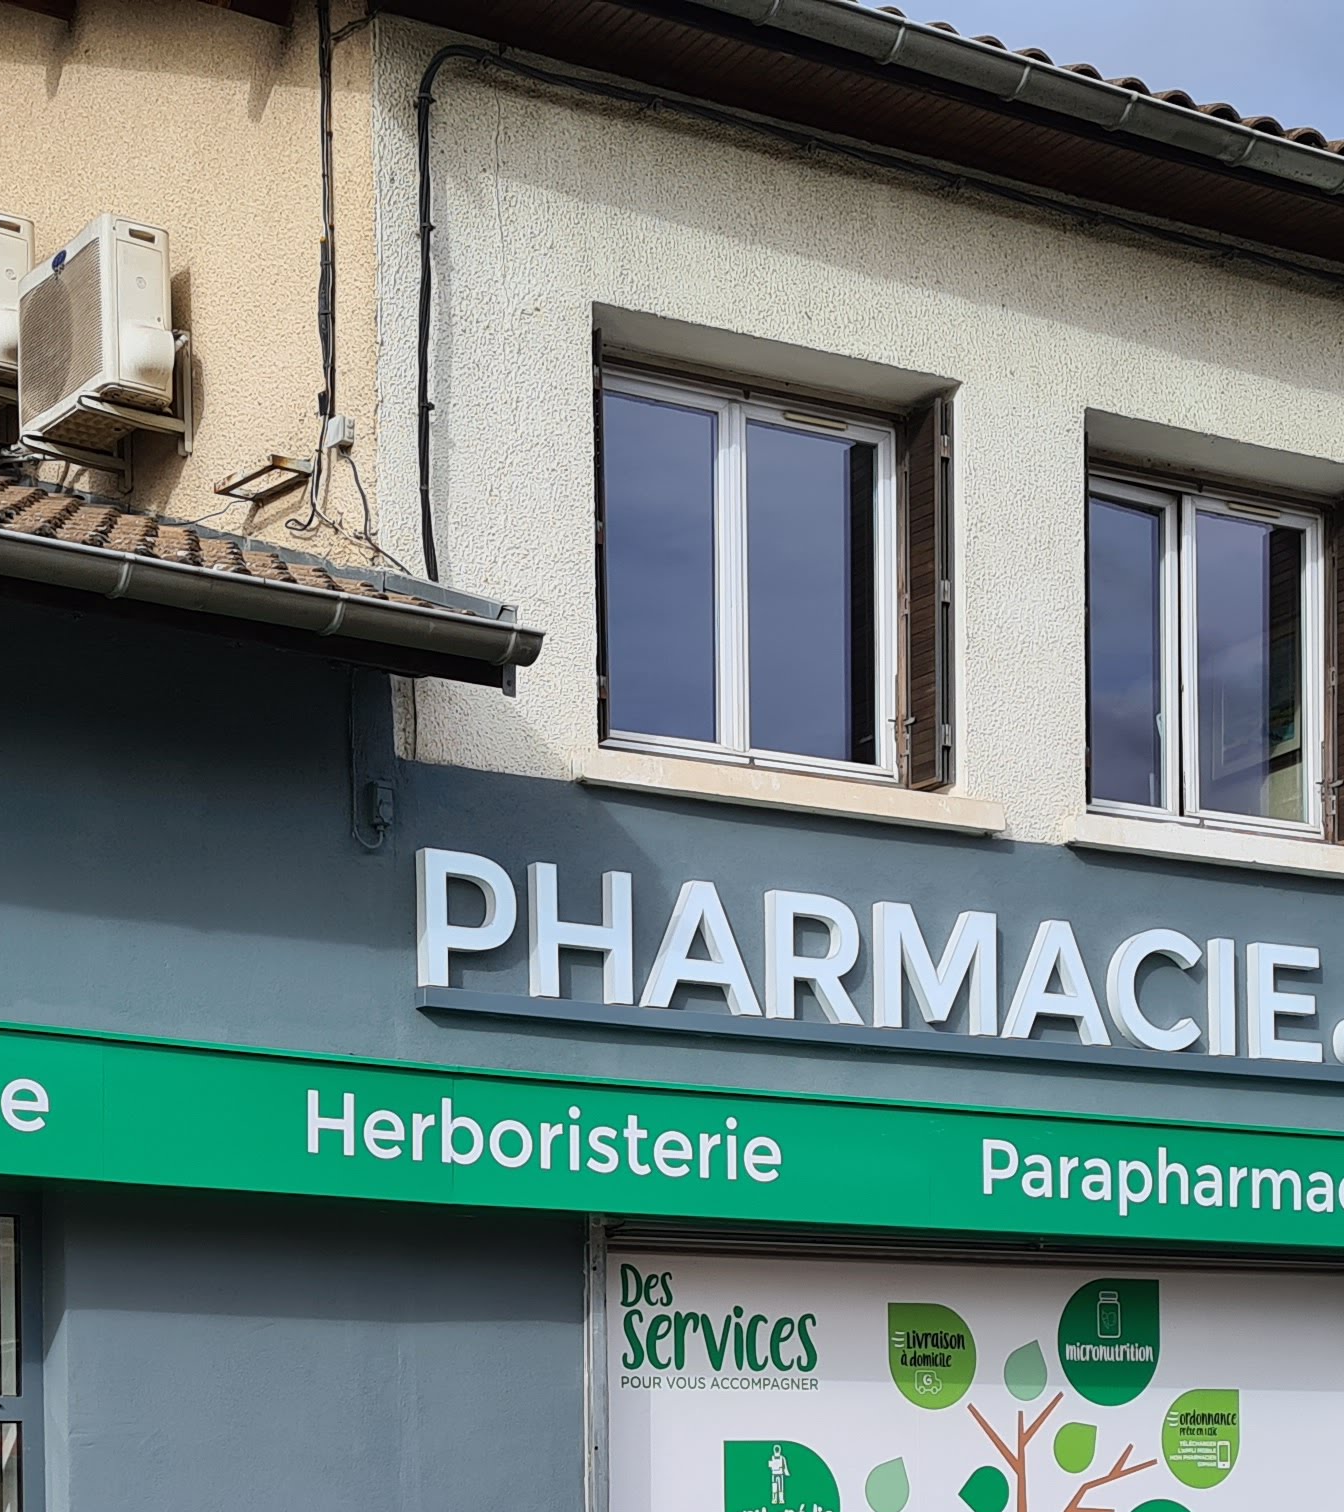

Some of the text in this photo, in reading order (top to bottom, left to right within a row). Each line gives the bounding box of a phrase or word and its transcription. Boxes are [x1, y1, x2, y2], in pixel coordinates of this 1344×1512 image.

[416, 847, 1323, 1062] PHARMACIE
[307, 1089, 782, 1182] Herboristerie
[620, 1263, 673, 1307] Des
[901, 1350, 952, 1367] à domicile
[1065, 1342, 1154, 1362] micronutrition
[621, 1376, 818, 1390] POUR VOUS ACCOMPAGNER
[1179, 1409, 1237, 1426] ordonnance
